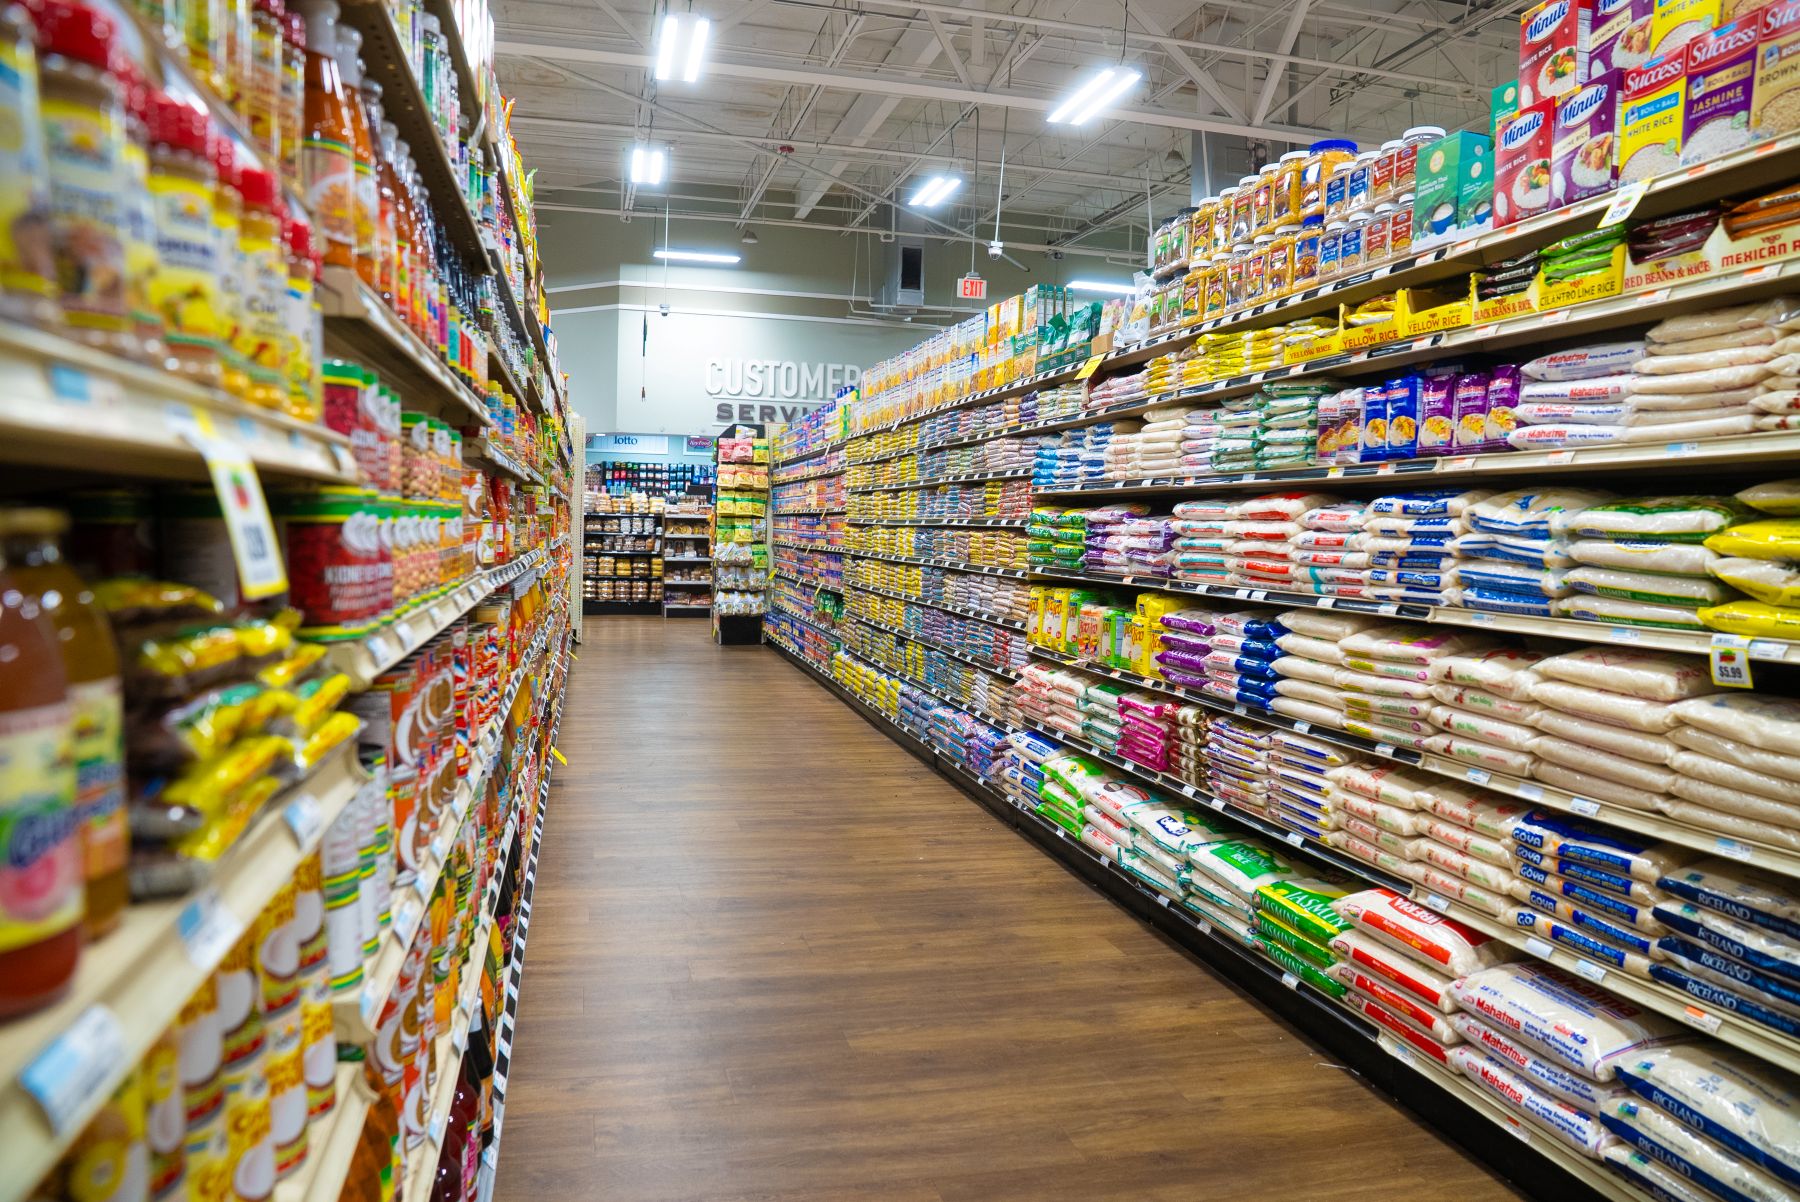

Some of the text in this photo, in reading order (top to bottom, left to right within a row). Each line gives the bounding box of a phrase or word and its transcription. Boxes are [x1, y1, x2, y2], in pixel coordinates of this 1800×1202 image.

[1527, 2, 1569, 41] Minute
[1616, 15, 1630, 27] RICE
[1660, 2, 1686, 19] WHITE
[1520, 44, 1553, 70] WHITE RICE
[1689, 25, 1758, 66] Success
[1625, 58, 1683, 95] Success
[1759, 63, 1799, 86] BROWN
[1561, 85, 1608, 124] Minute
[1640, 97, 1677, 116] BOIL BAG
[1692, 86, 1744, 114] JASMINE
[1502, 113, 1544, 148] Minute
[1627, 114, 1674, 138] WHITE RICE
[1496, 154, 1527, 177] WHITE RICE
[1721, 243, 1788, 267] MEXICAN
[1624, 260, 1710, 289] RED BEANS & RICE
[963, 280, 984, 297] EXIT
[1540, 280, 1616, 306] CILANTRO LIME RICE
[1474, 308, 1491, 321] BLACK
[1491, 304, 1511, 318] BEANS
[1518, 298, 1532, 310] RICE
[1408, 315, 1461, 333] YELLOW RICE
[1342, 329, 1398, 348] YELLOW RICE
[1290, 344, 1332, 359] YELLOW RICE
[704, 358, 862, 402] CUSTOMER
[1569, 386, 1610, 398] Mahatma
[614, 435, 638, 446] lotto
[1718, 665, 1743, 679] $5.99
[1512, 829, 1542, 848] GOYA
[1230, 853, 1251, 865] RICE
[1516, 846, 1541, 865] GOYA
[1520, 866, 1546, 883] GOYA
[1261, 896, 1300, 928] JASMINE
[1284, 891, 1350, 930] JASMIN
[1530, 892, 1556, 912] GOYA
[1698, 892, 1751, 921] RICELAND
[1260, 919, 1297, 952] JASMINE
[1267, 945, 1305, 976] JASMINE
[1700, 952, 1752, 982] RICELAND
[1686, 979, 1737, 1010] RICELAND
[1476, 997, 1521, 1031] Mahatma
[1481, 1031, 1528, 1067] Mahatma
[1550, 1032, 1573, 1053] Enriched
[1480, 1066, 1524, 1105] Mahatma
[1553, 1110, 1576, 1128] Enriched
[1652, 1090, 1704, 1131] RICELAND
[1637, 1136, 1692, 1178] RICELAND
